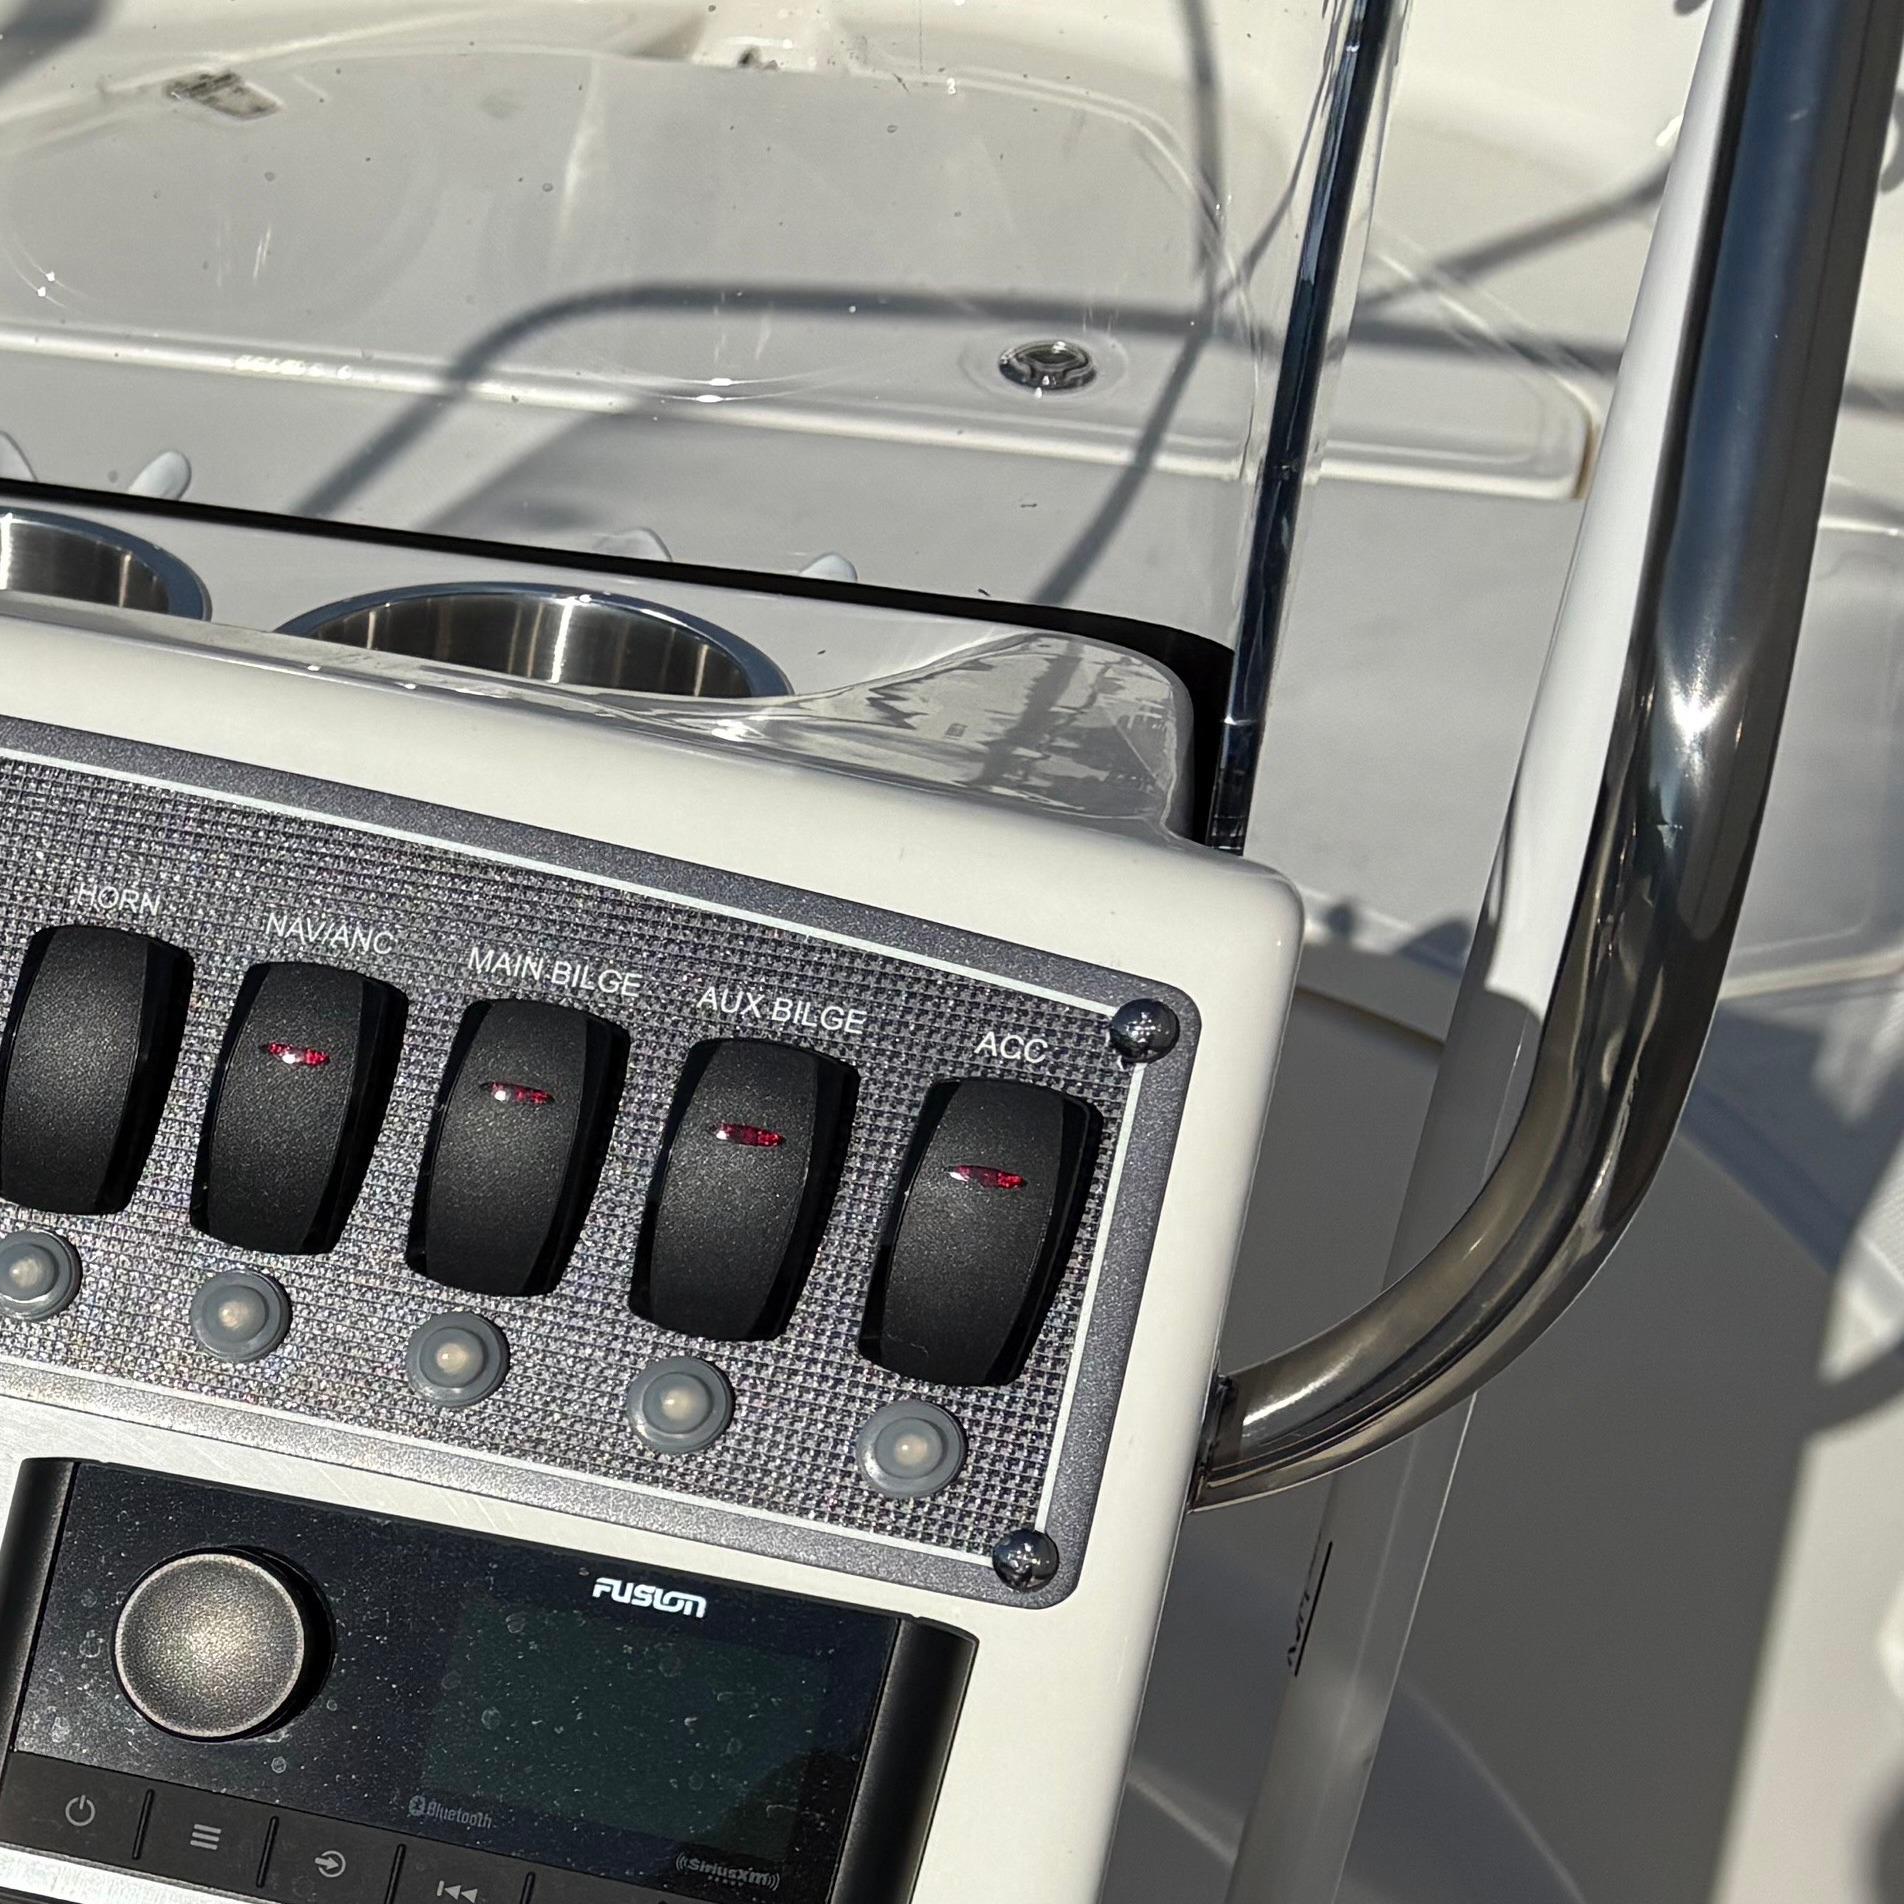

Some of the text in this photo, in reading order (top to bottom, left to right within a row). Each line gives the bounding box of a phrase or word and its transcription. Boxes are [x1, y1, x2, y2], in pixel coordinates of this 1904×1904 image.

[76, 885, 161, 916] HORN
[265, 912, 395, 955] NAV/ANC
[468, 947, 643, 998] MAIN BILGE
[699, 986, 868, 1035] AUX BILGE
[974, 1032, 1050, 1063] ACC
[426, 1801, 493, 1829] Bluetooth
